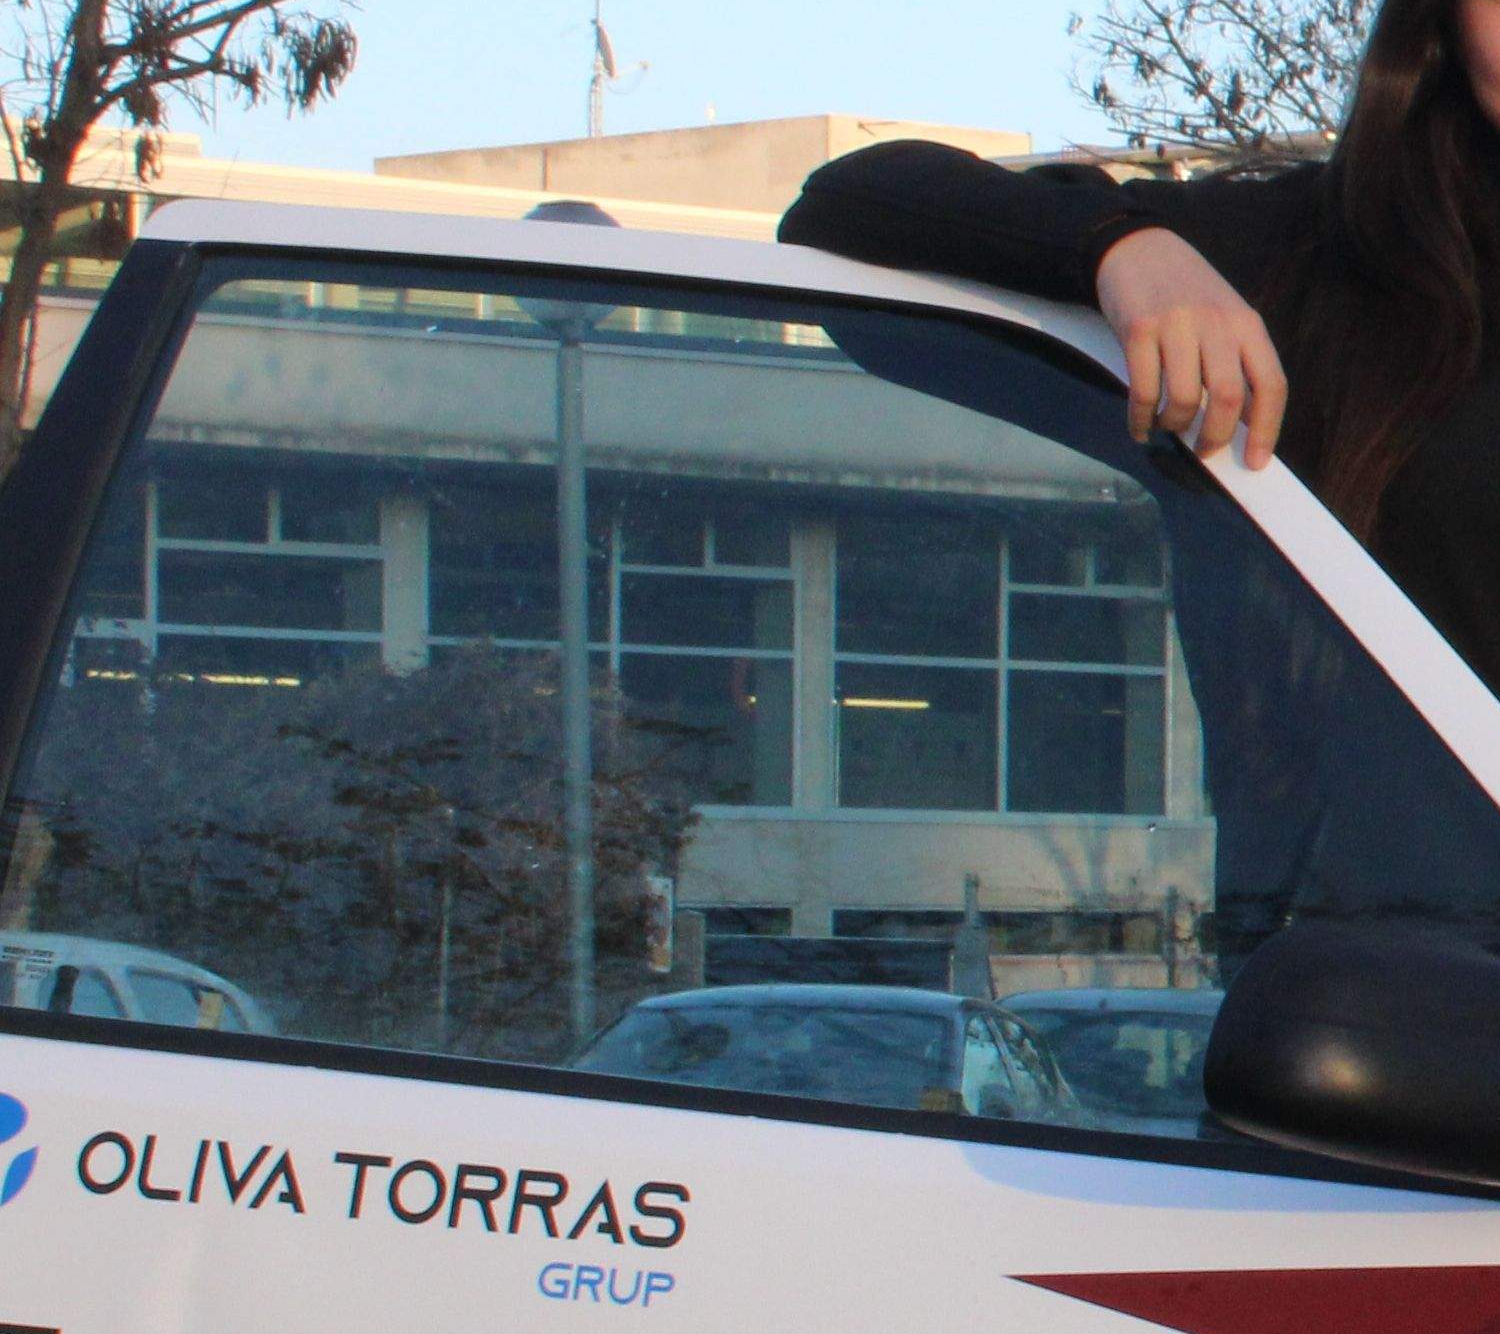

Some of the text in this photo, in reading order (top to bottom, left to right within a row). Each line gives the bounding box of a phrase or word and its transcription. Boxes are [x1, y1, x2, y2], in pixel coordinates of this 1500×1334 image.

[76, 1129, 691, 1250] OLIVA TORRAS
[537, 1261, 676, 1308] GRUP
